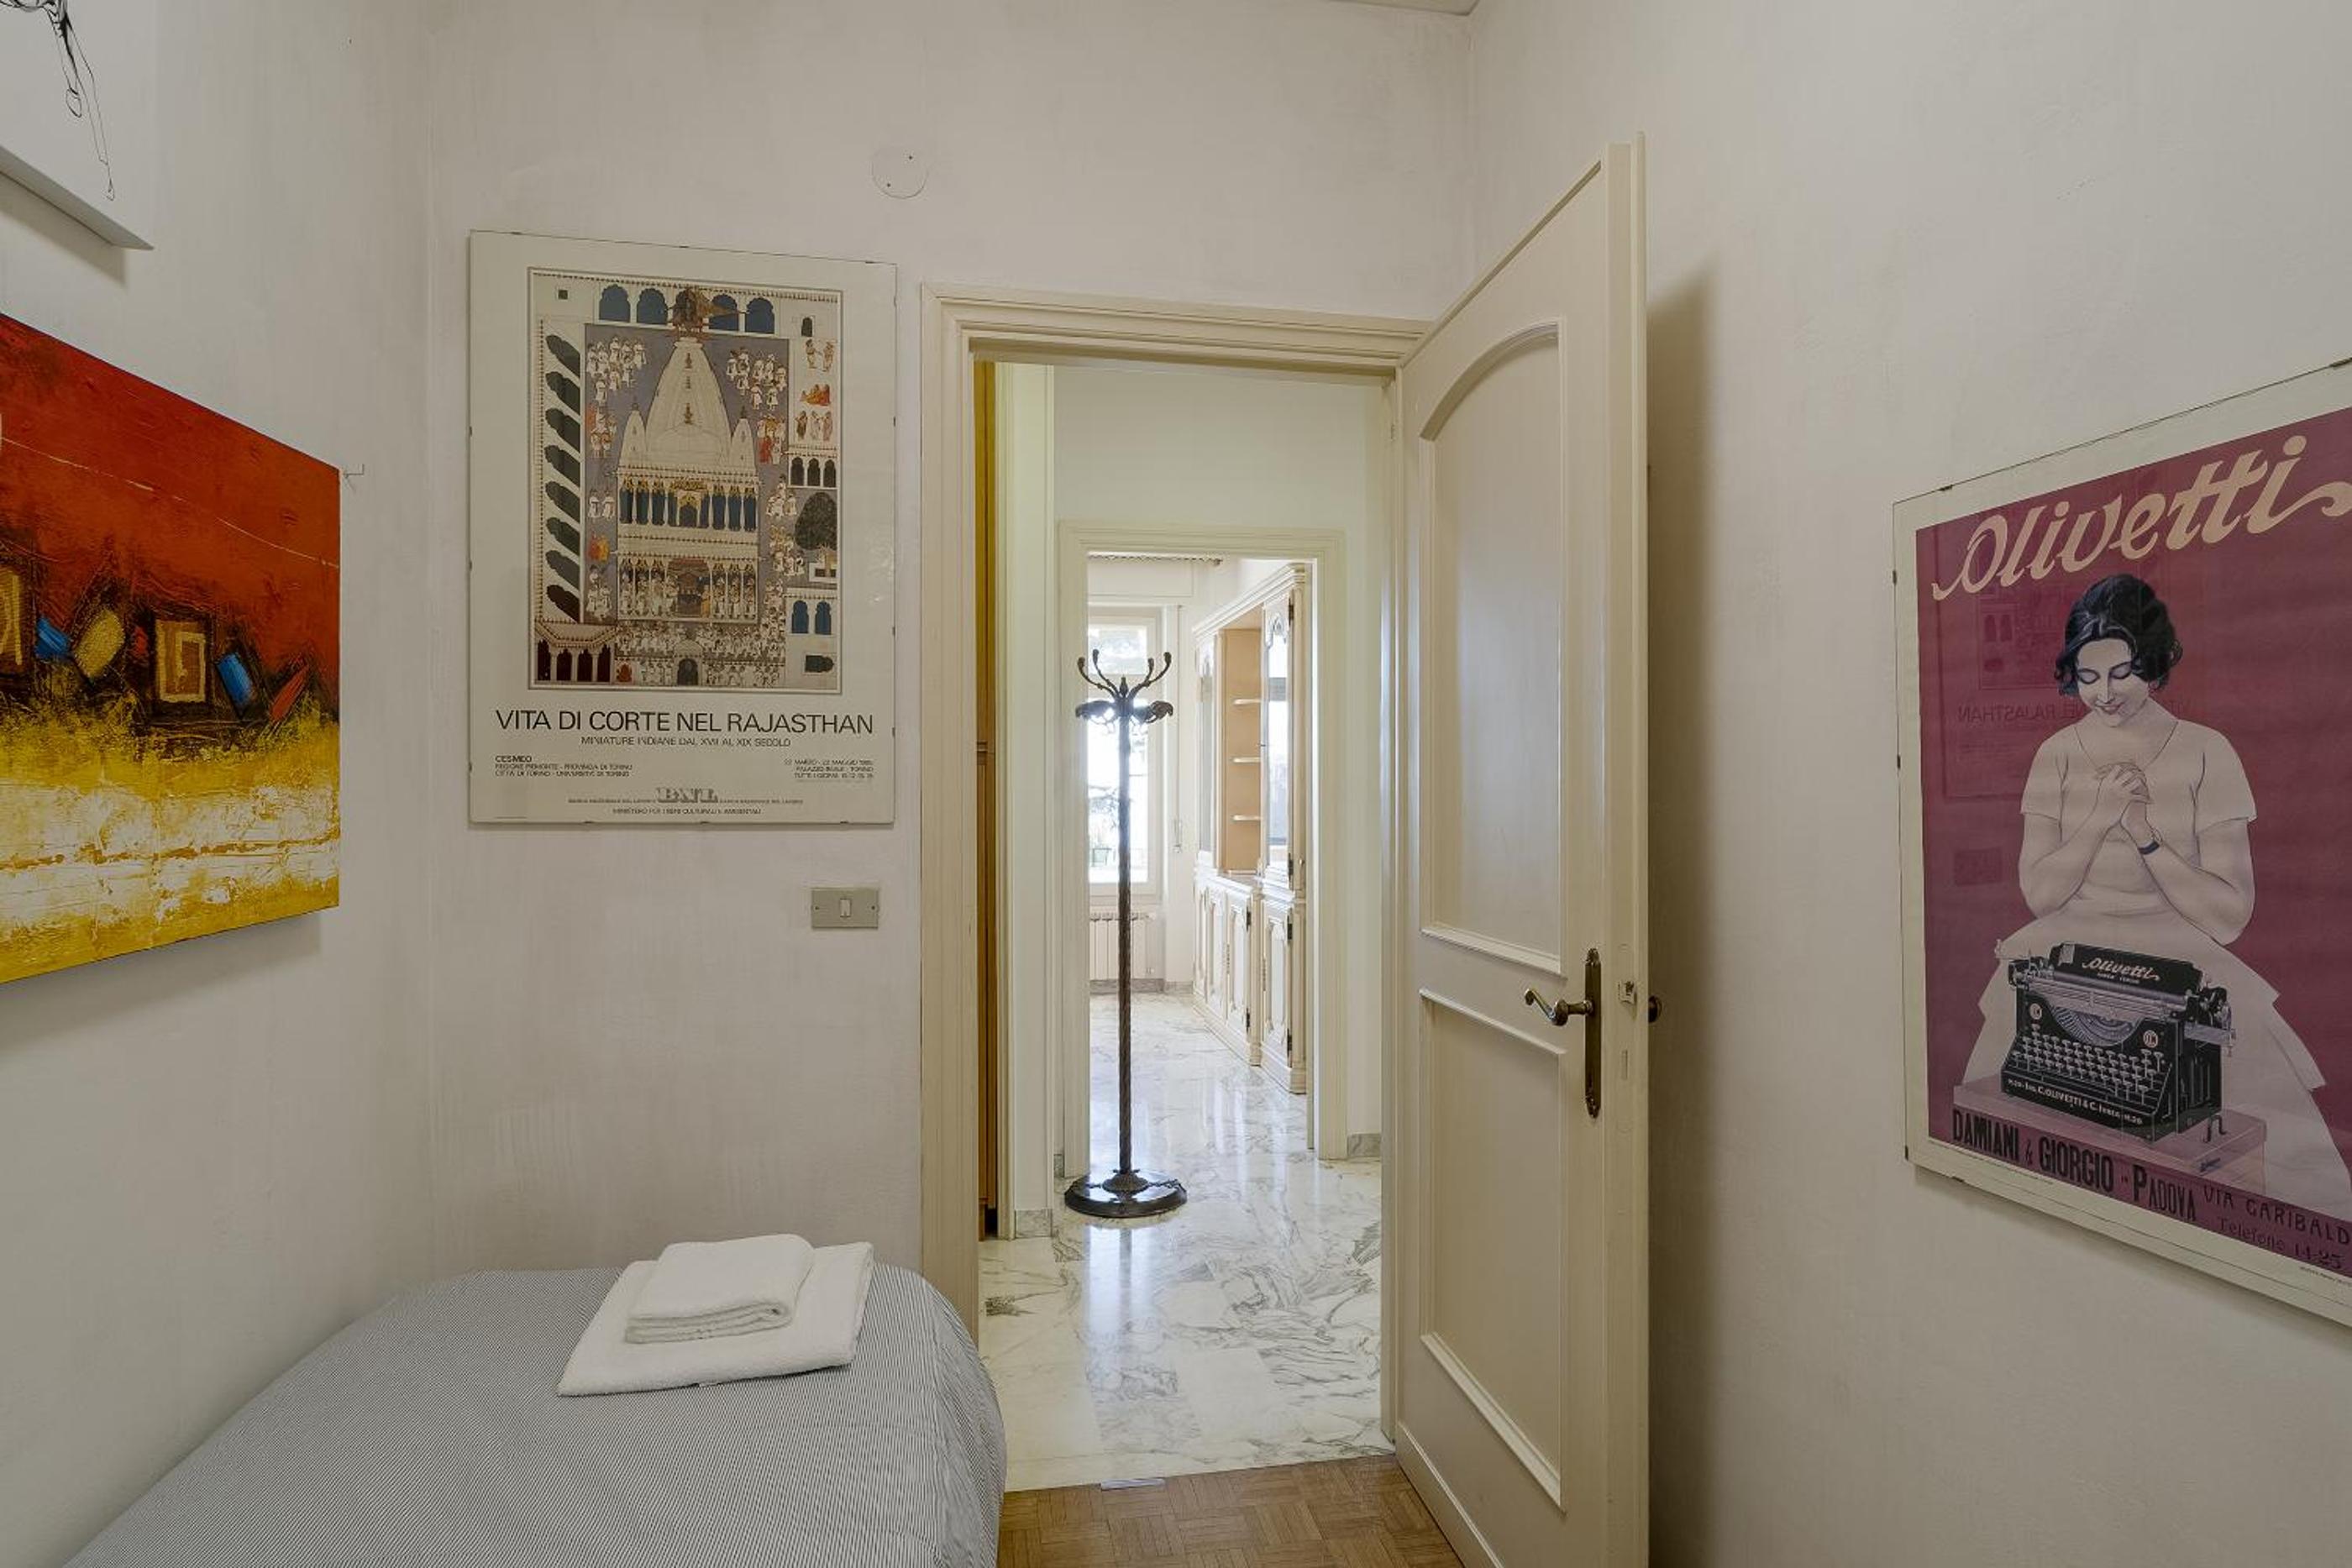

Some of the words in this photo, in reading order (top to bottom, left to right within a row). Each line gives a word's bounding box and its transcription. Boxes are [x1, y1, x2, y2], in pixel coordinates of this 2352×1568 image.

[1932, 435, 2352, 600] Olivetti
[496, 709, 551, 731] VITA
[559, 711, 581, 731] DI
[589, 711, 669, 732] CORTE
[677, 713, 722, 732] NEL
[728, 714, 873, 735] RAJASTHAN
[580, 736, 633, 746] MINIATURE
[638, 737, 675, 746] INDIANE
[679, 737, 697, 746] DAL
[736, 737, 752, 746] XIX
[755, 737, 791, 747] SECOLO
[2082, 957, 2160, 982] Olivetti
[1952, 1109, 2019, 1161] DAMIANI
[2038, 1136, 2114, 1193] GIORGIO
[2132, 1163, 2197, 1222] PADOVA
[2203, 1185, 2234, 1209] VIA
